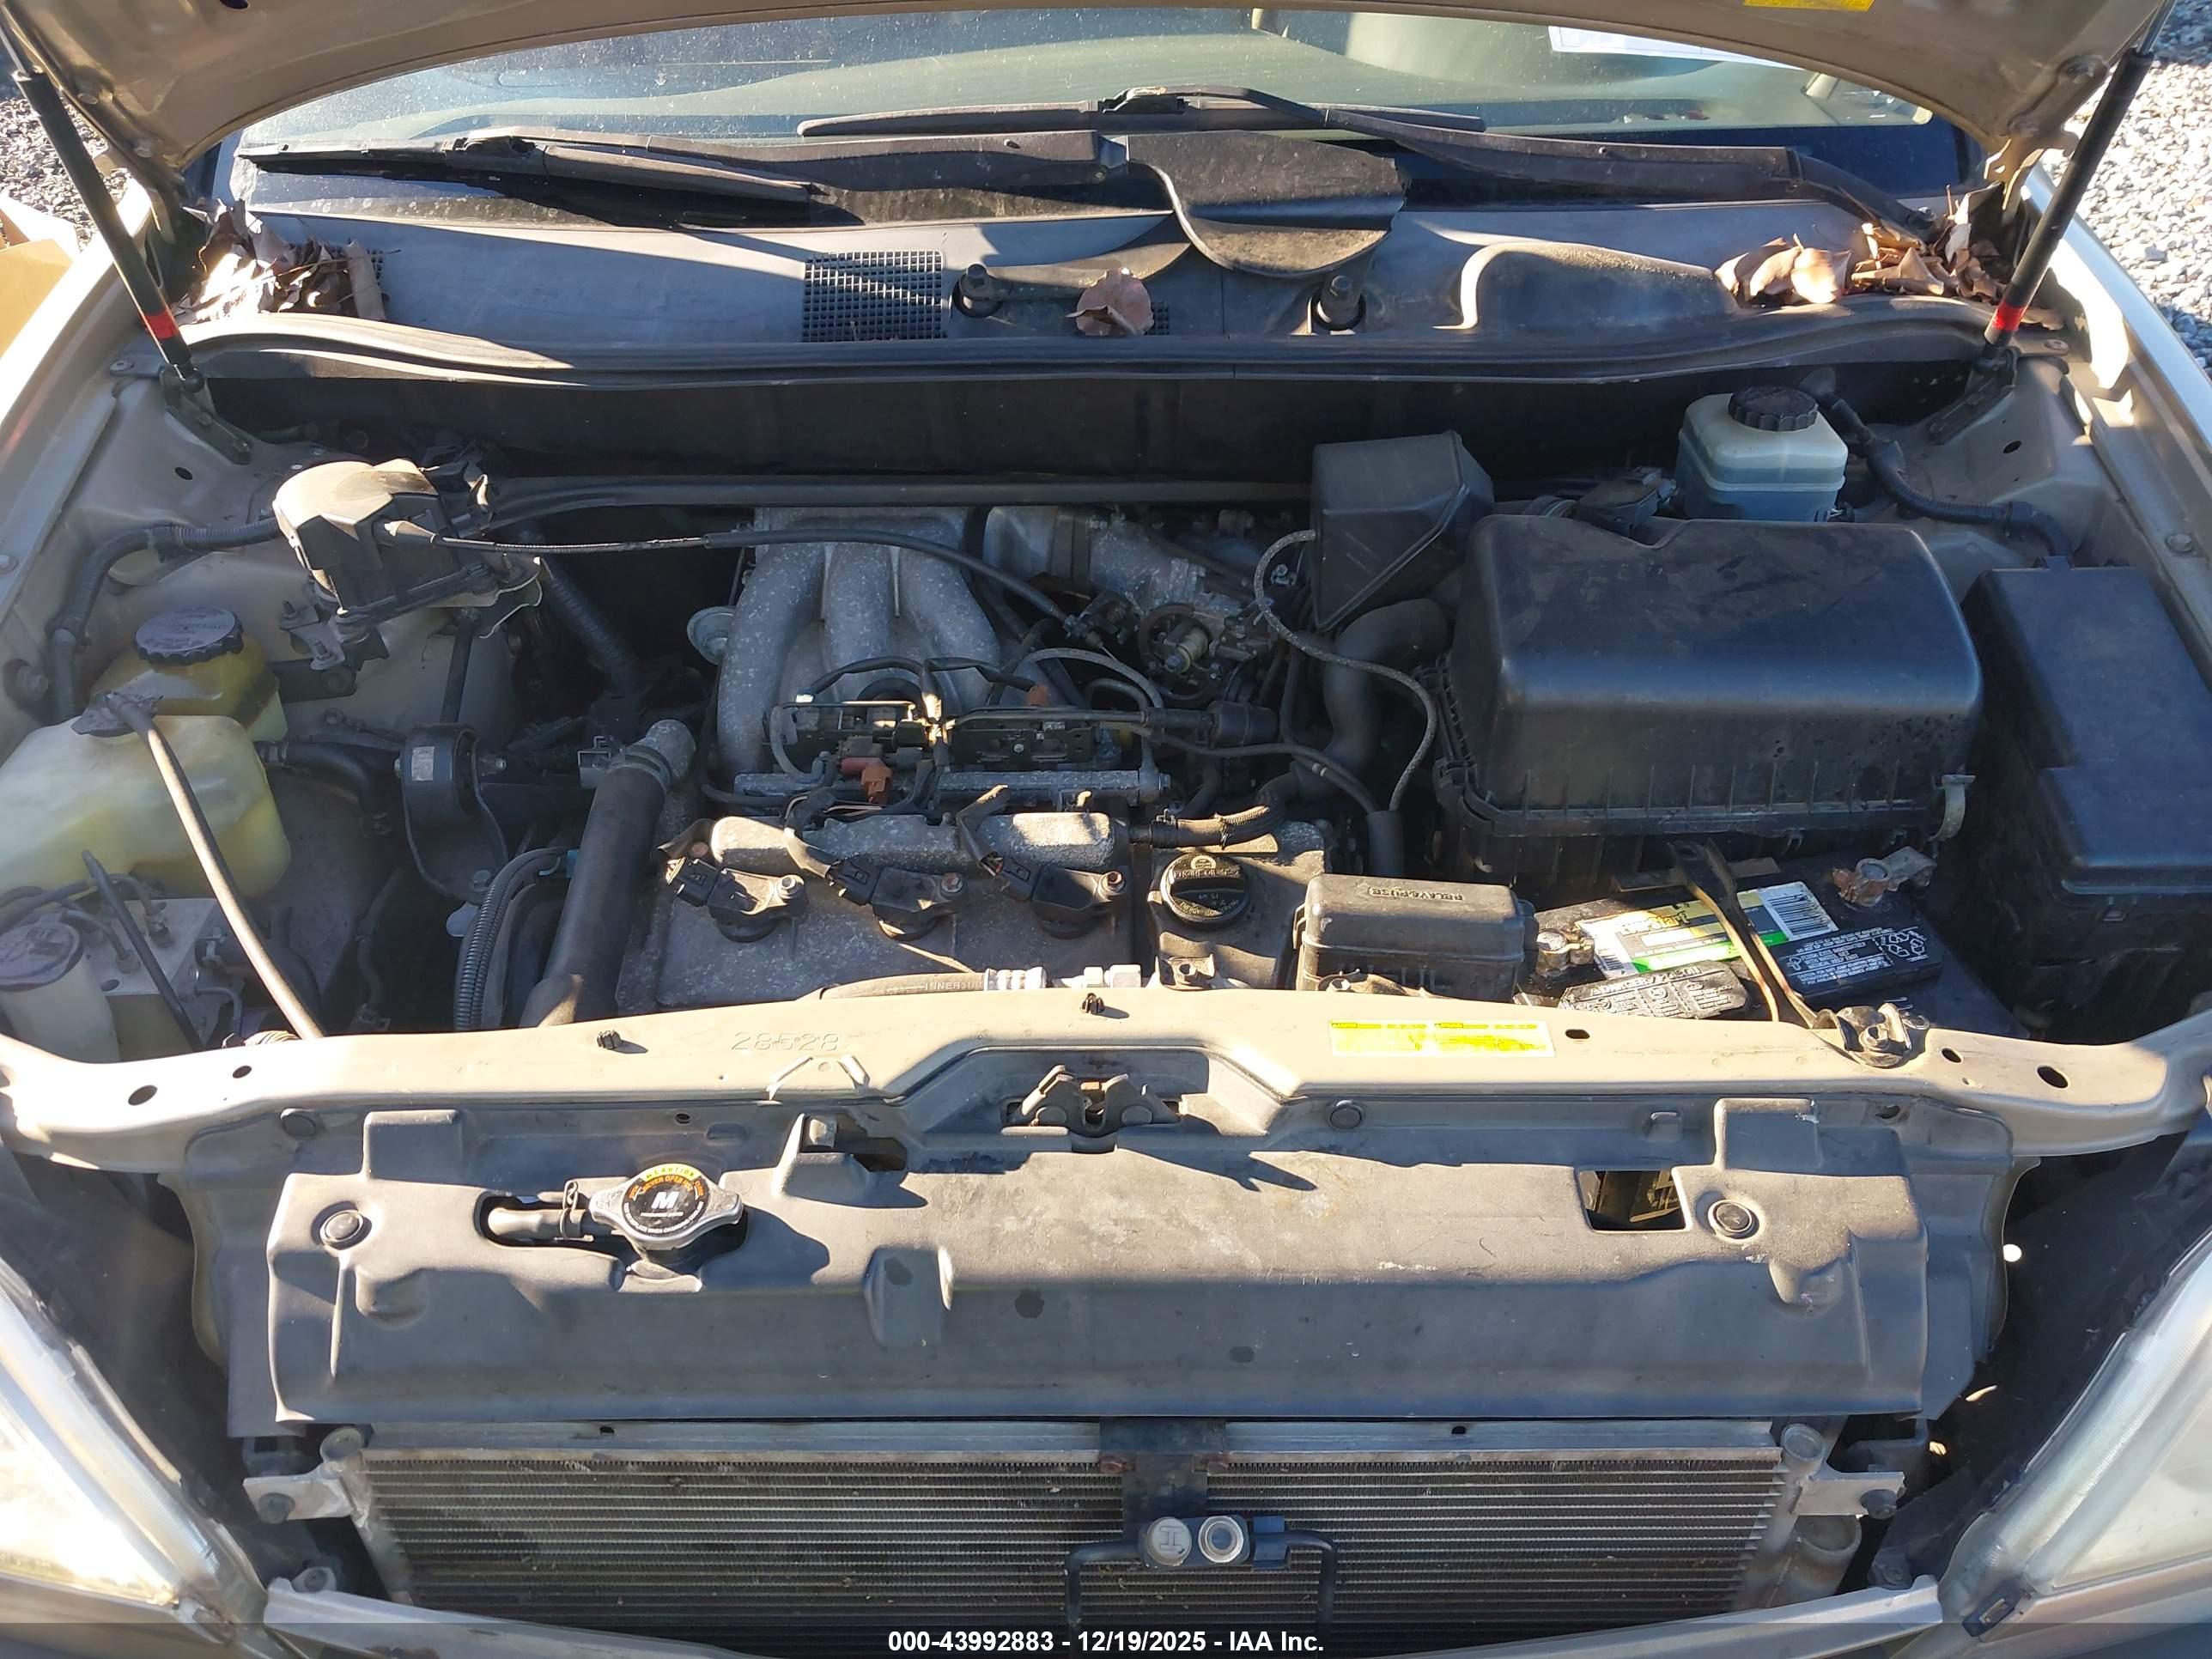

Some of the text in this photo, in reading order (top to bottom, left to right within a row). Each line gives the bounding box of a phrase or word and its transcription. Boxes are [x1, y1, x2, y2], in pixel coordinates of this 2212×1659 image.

[730, 1031, 839, 1051] 28528
[653, 1166, 696, 1178] CAUTION
[651, 1191, 679, 1209] M
